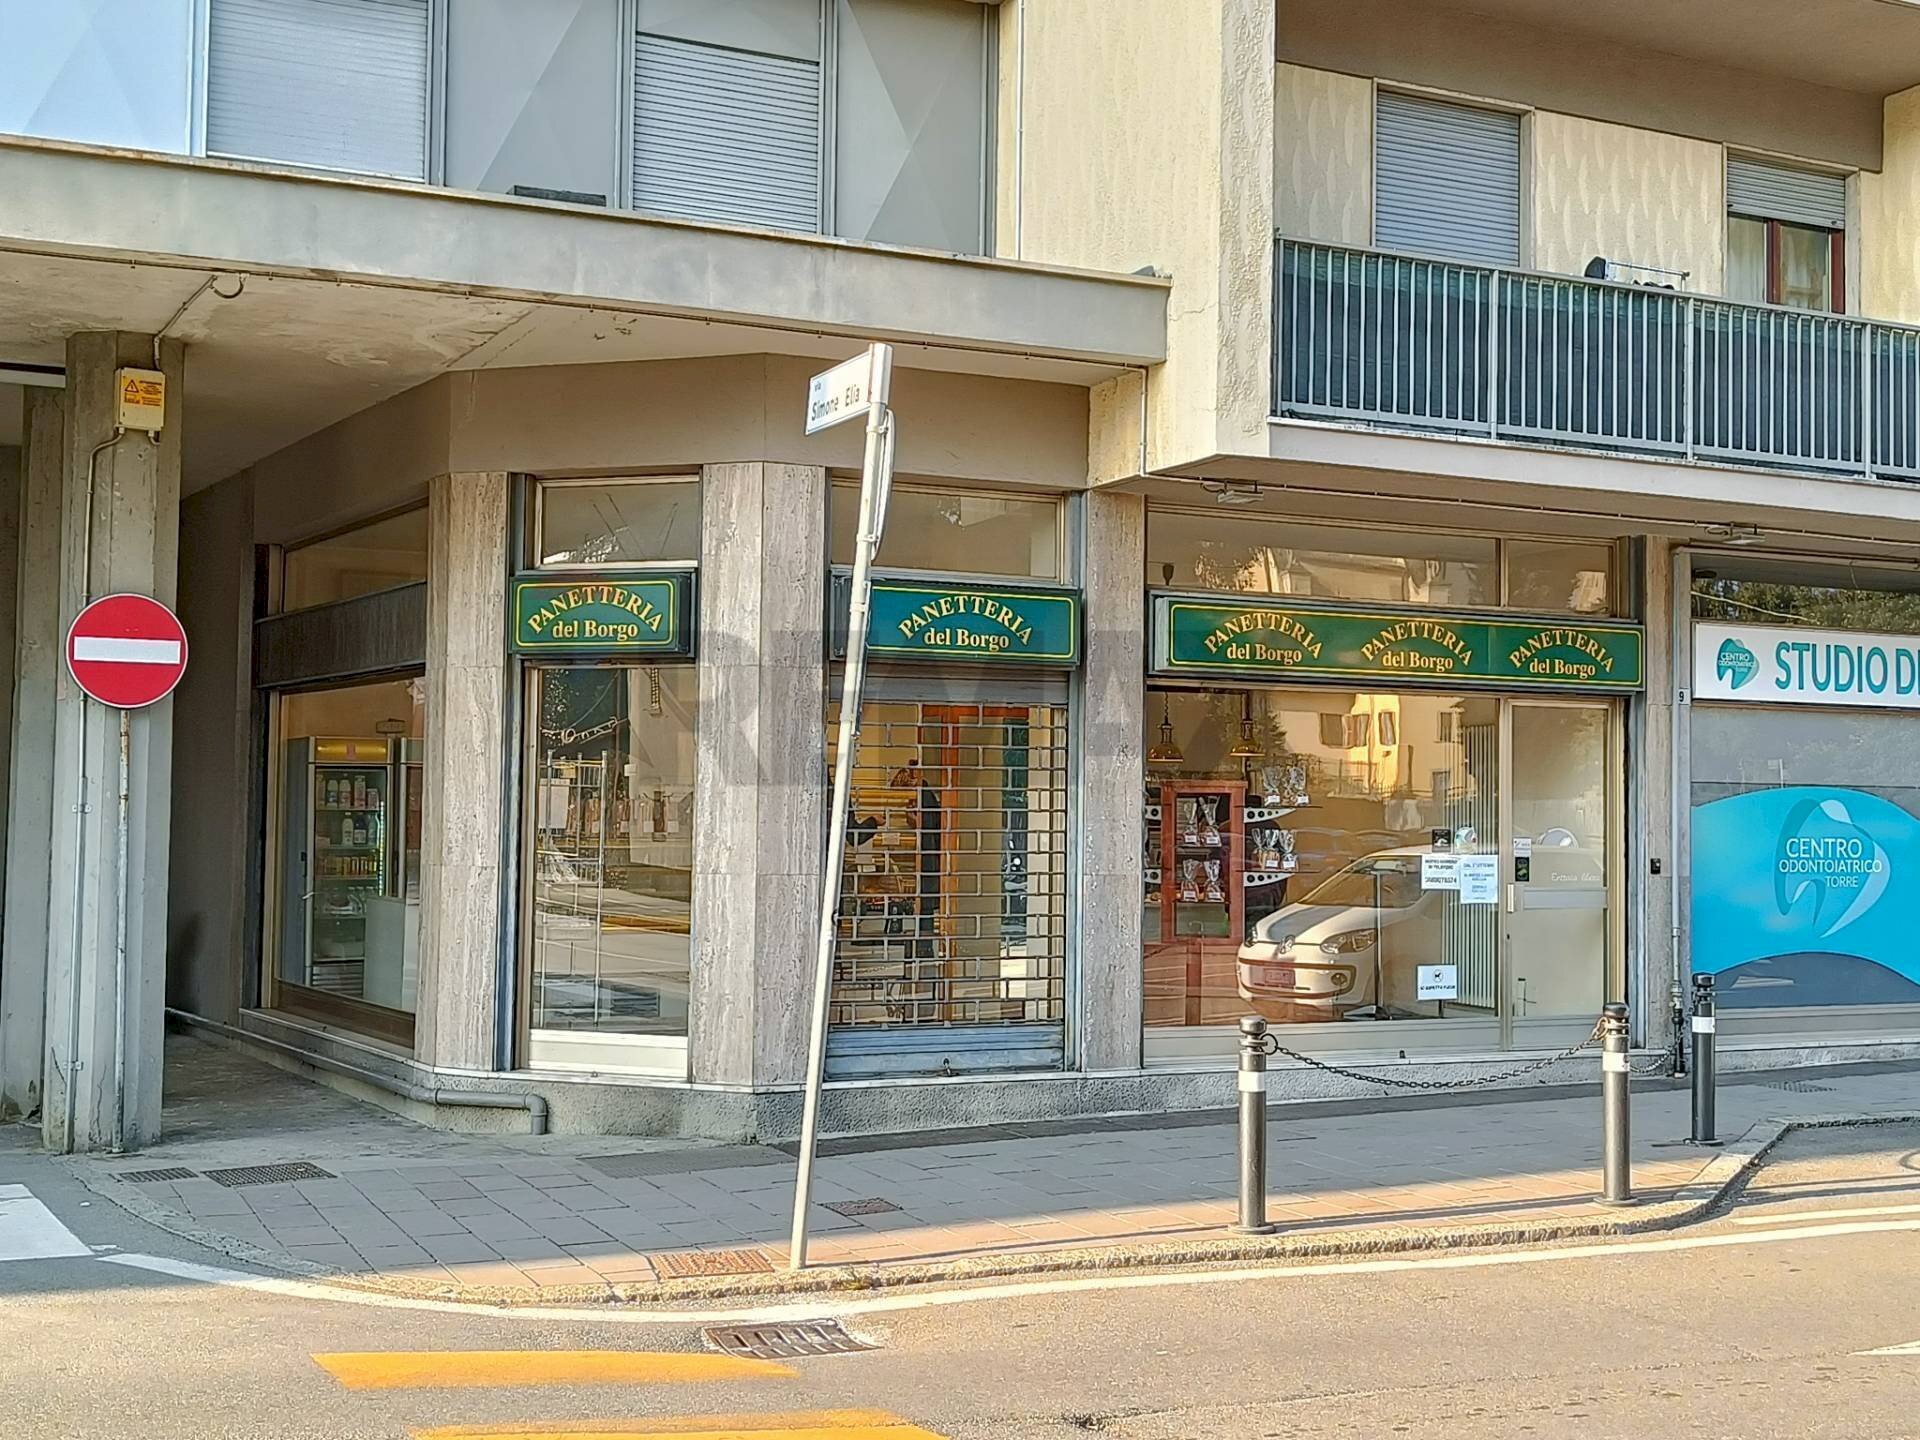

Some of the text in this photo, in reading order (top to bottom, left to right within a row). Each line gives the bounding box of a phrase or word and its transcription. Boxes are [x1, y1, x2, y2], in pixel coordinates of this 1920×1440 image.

[811, 384, 860, 421] Simone Elia
[527, 585, 663, 634] PANETTERIA
[898, 595, 1033, 646] PANETTERIA
[552, 619, 639, 641] del Borgo
[924, 627, 1010, 653] del Borgo
[1204, 612, 1322, 660] PANETTERIA
[1227, 643, 1302, 666] del Borgo
[1361, 621, 1472, 667] PANETTERIA
[1509, 629, 1614, 673] PANETTERIA
[1382, 651, 1453, 673] del Borgo
[1720, 652, 1750, 662] CENTRO
[1775, 641, 1920, 695] STUDIO D
[1529, 658, 1596, 680] del Borgo
[1679, 691, 1685, 703] 9
[1786, 838, 1863, 858] CENTRO
[1778, 859, 1883, 873] ODONTOIATRICO
[1825, 876, 1859, 888] TORRE
